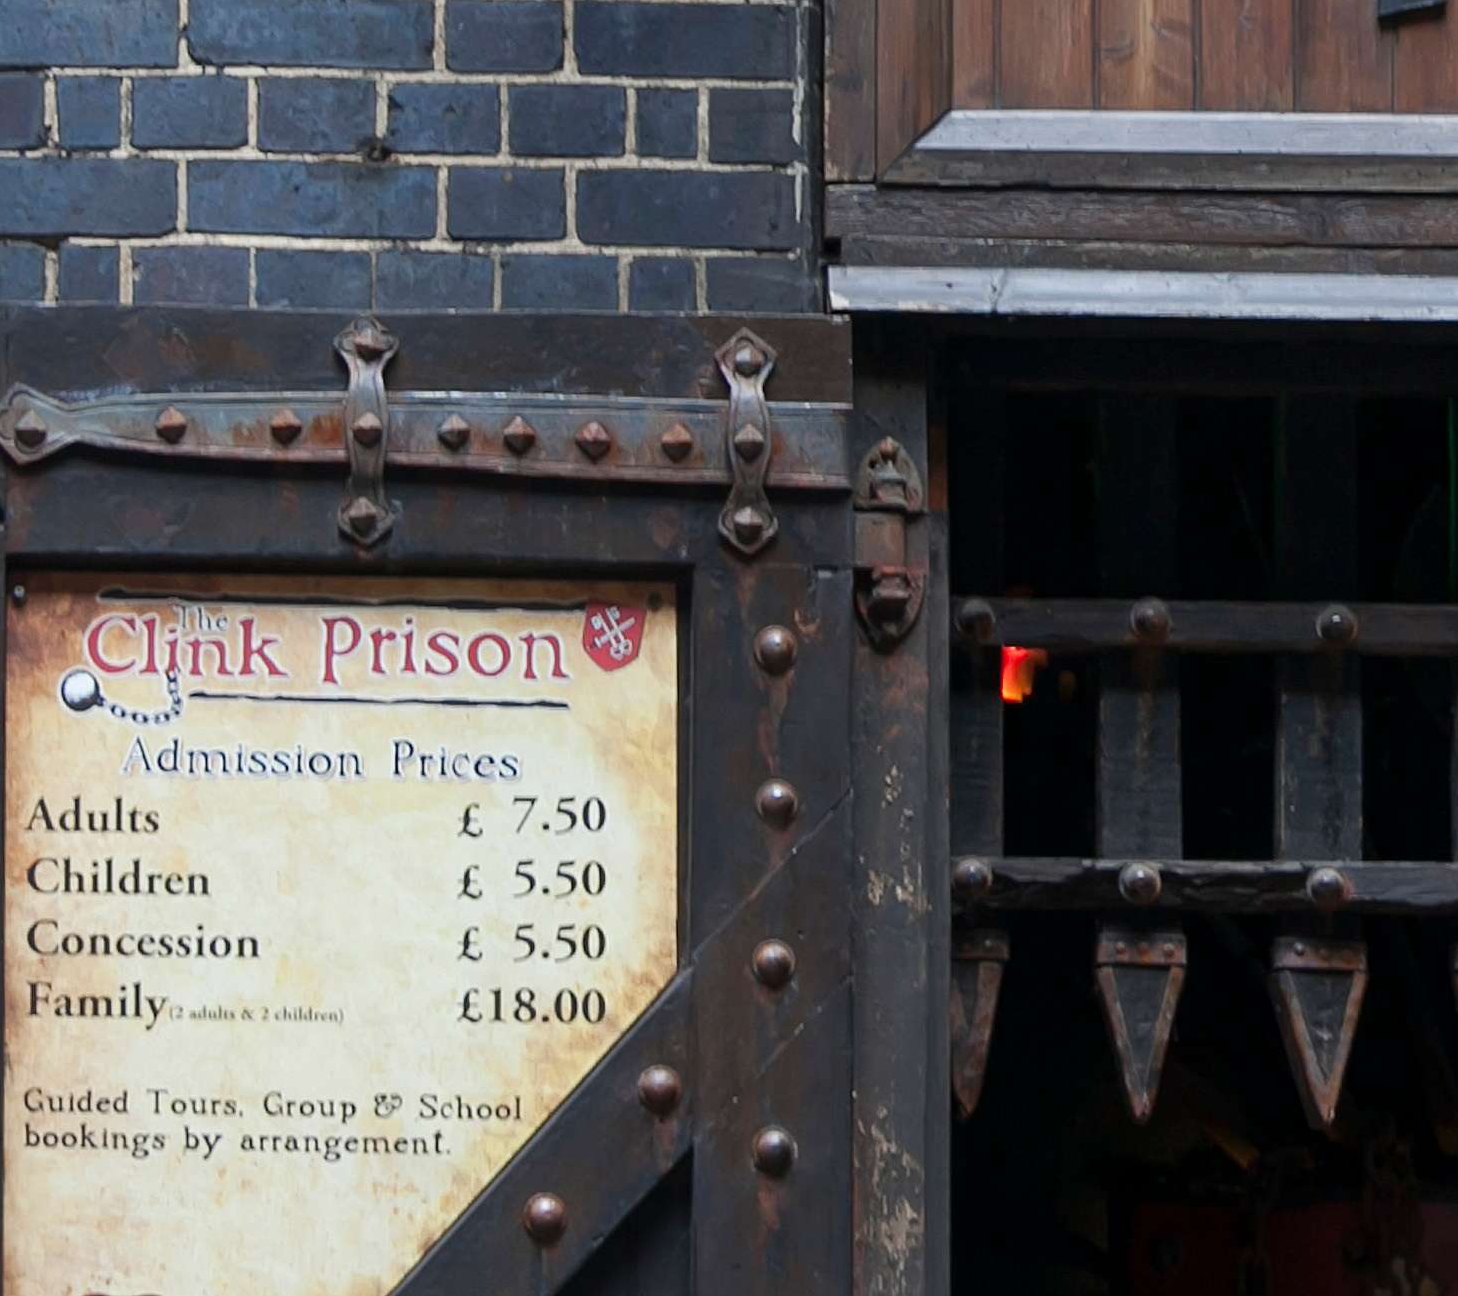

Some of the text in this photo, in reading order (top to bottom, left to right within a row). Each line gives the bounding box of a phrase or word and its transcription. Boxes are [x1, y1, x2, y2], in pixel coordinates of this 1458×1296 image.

[173, 607, 228, 631] The
[86, 615, 570, 684] Clink Prison
[123, 737, 520, 779] Admission Prices
[25, 796, 606, 836] Adults £ 7.50
[26, 858, 606, 899] Children £ 5.50
[26, 919, 606, 961] Concession £ 5.50
[26, 982, 168, 1029] Family
[189, 1006, 235, 1020] adults
[262, 1008, 269, 1021] 2
[274, 1008, 344, 1025] children)
[456, 988, 606, 1025] £18.00
[24, 1089, 128, 1115] Guided
[263, 1093, 357, 1124] Group
[373, 1096, 403, 1119] &
[420, 1095, 523, 1121] School
[24, 1126, 451, 1161] bookings by arrangement.
